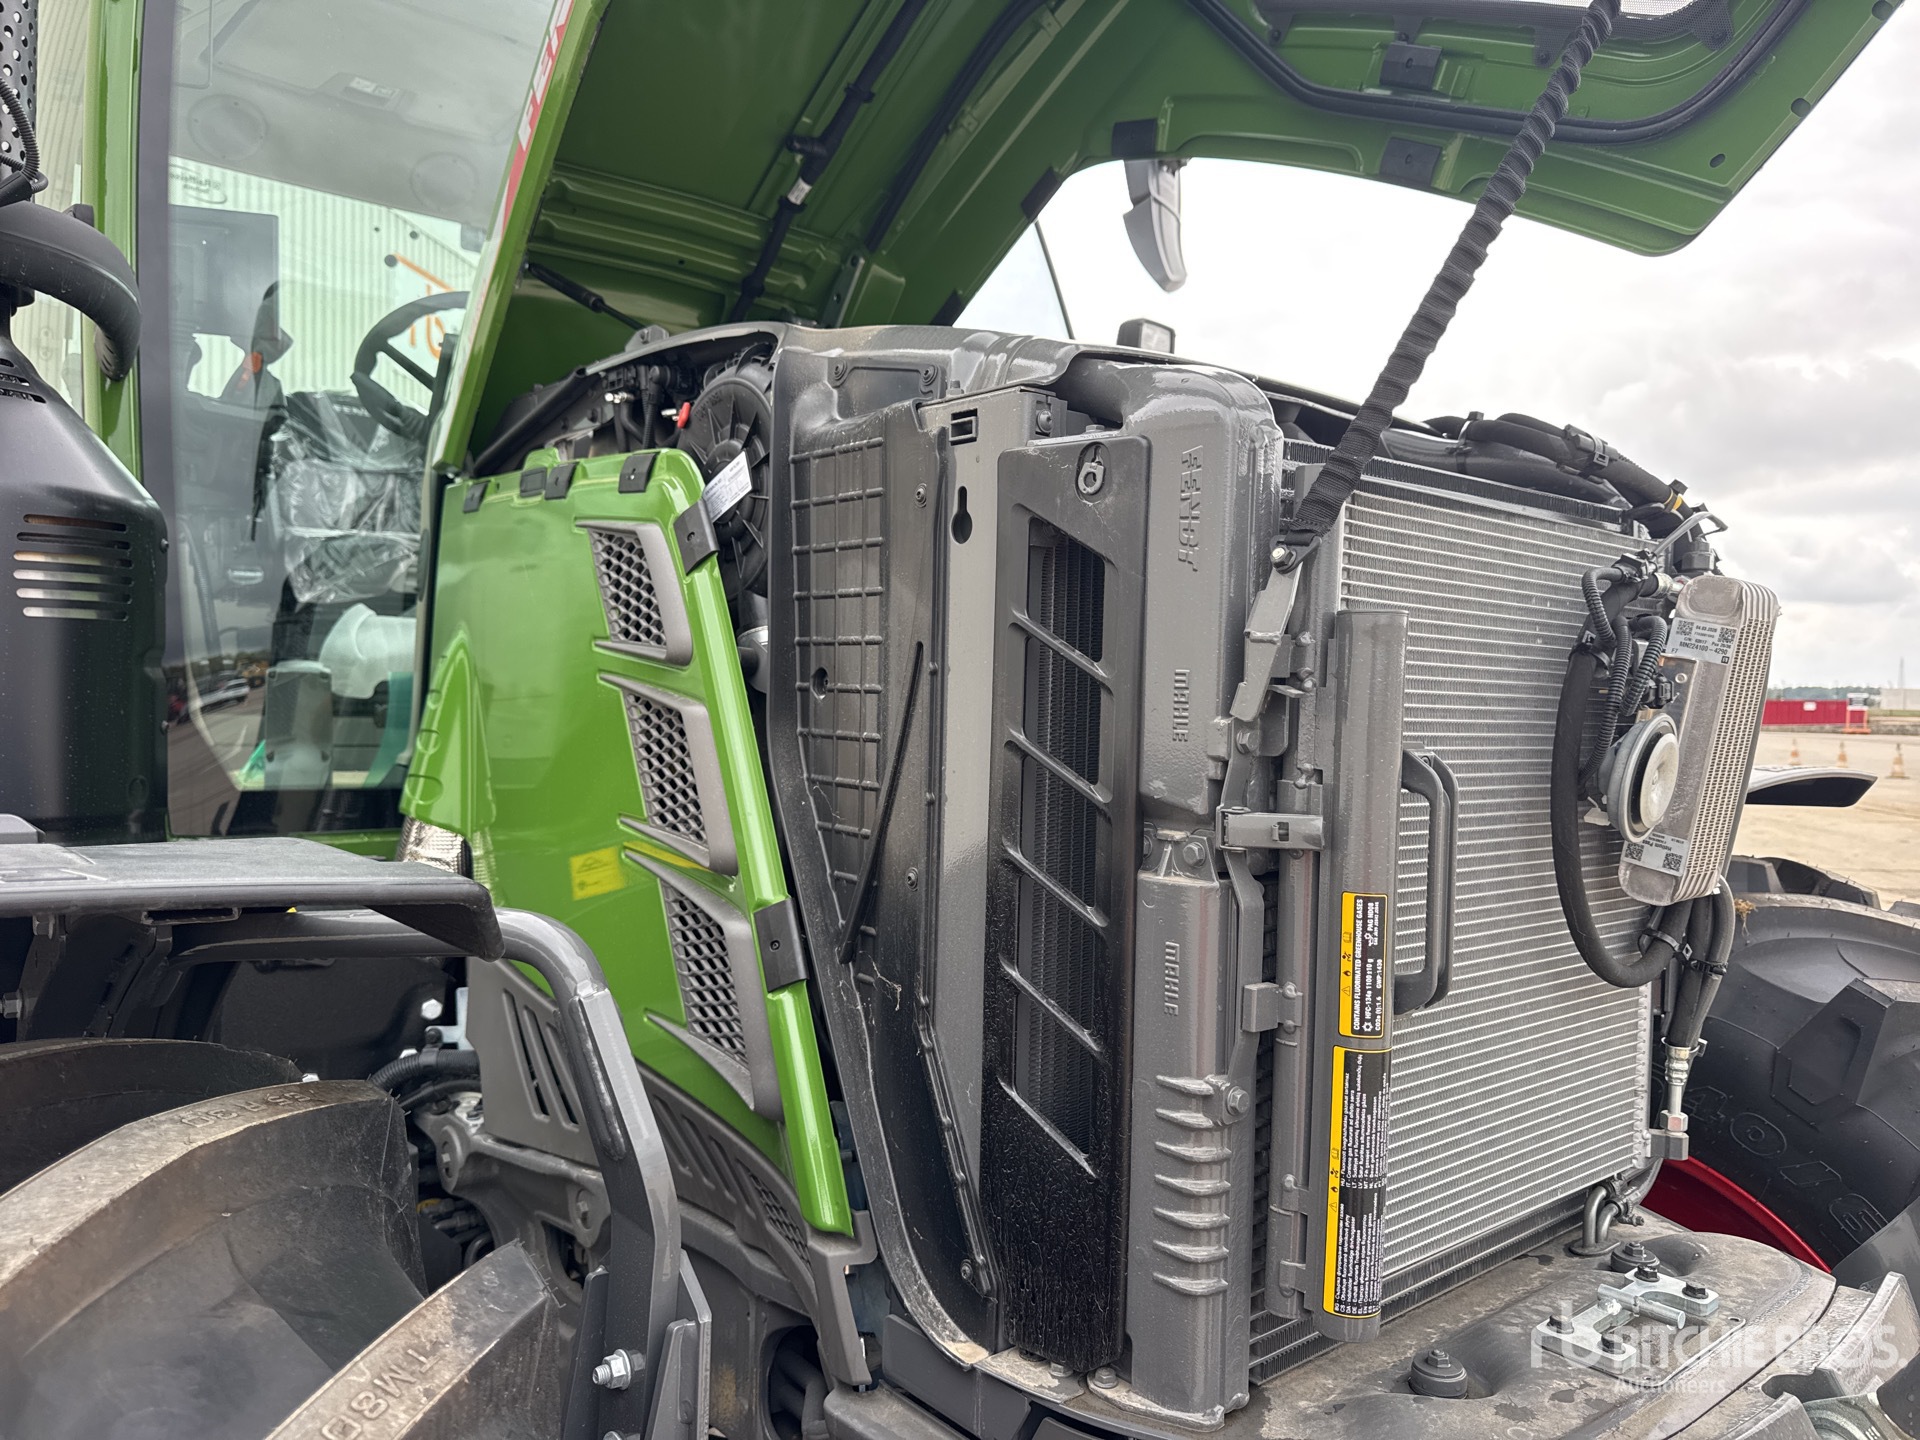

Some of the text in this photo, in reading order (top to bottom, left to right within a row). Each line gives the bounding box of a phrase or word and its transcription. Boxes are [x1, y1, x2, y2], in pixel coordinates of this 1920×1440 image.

[1178, 445, 1203, 572] FENDT
[1172, 669, 1190, 742] MAHLE
[1164, 941, 1180, 1016] MAHLE
